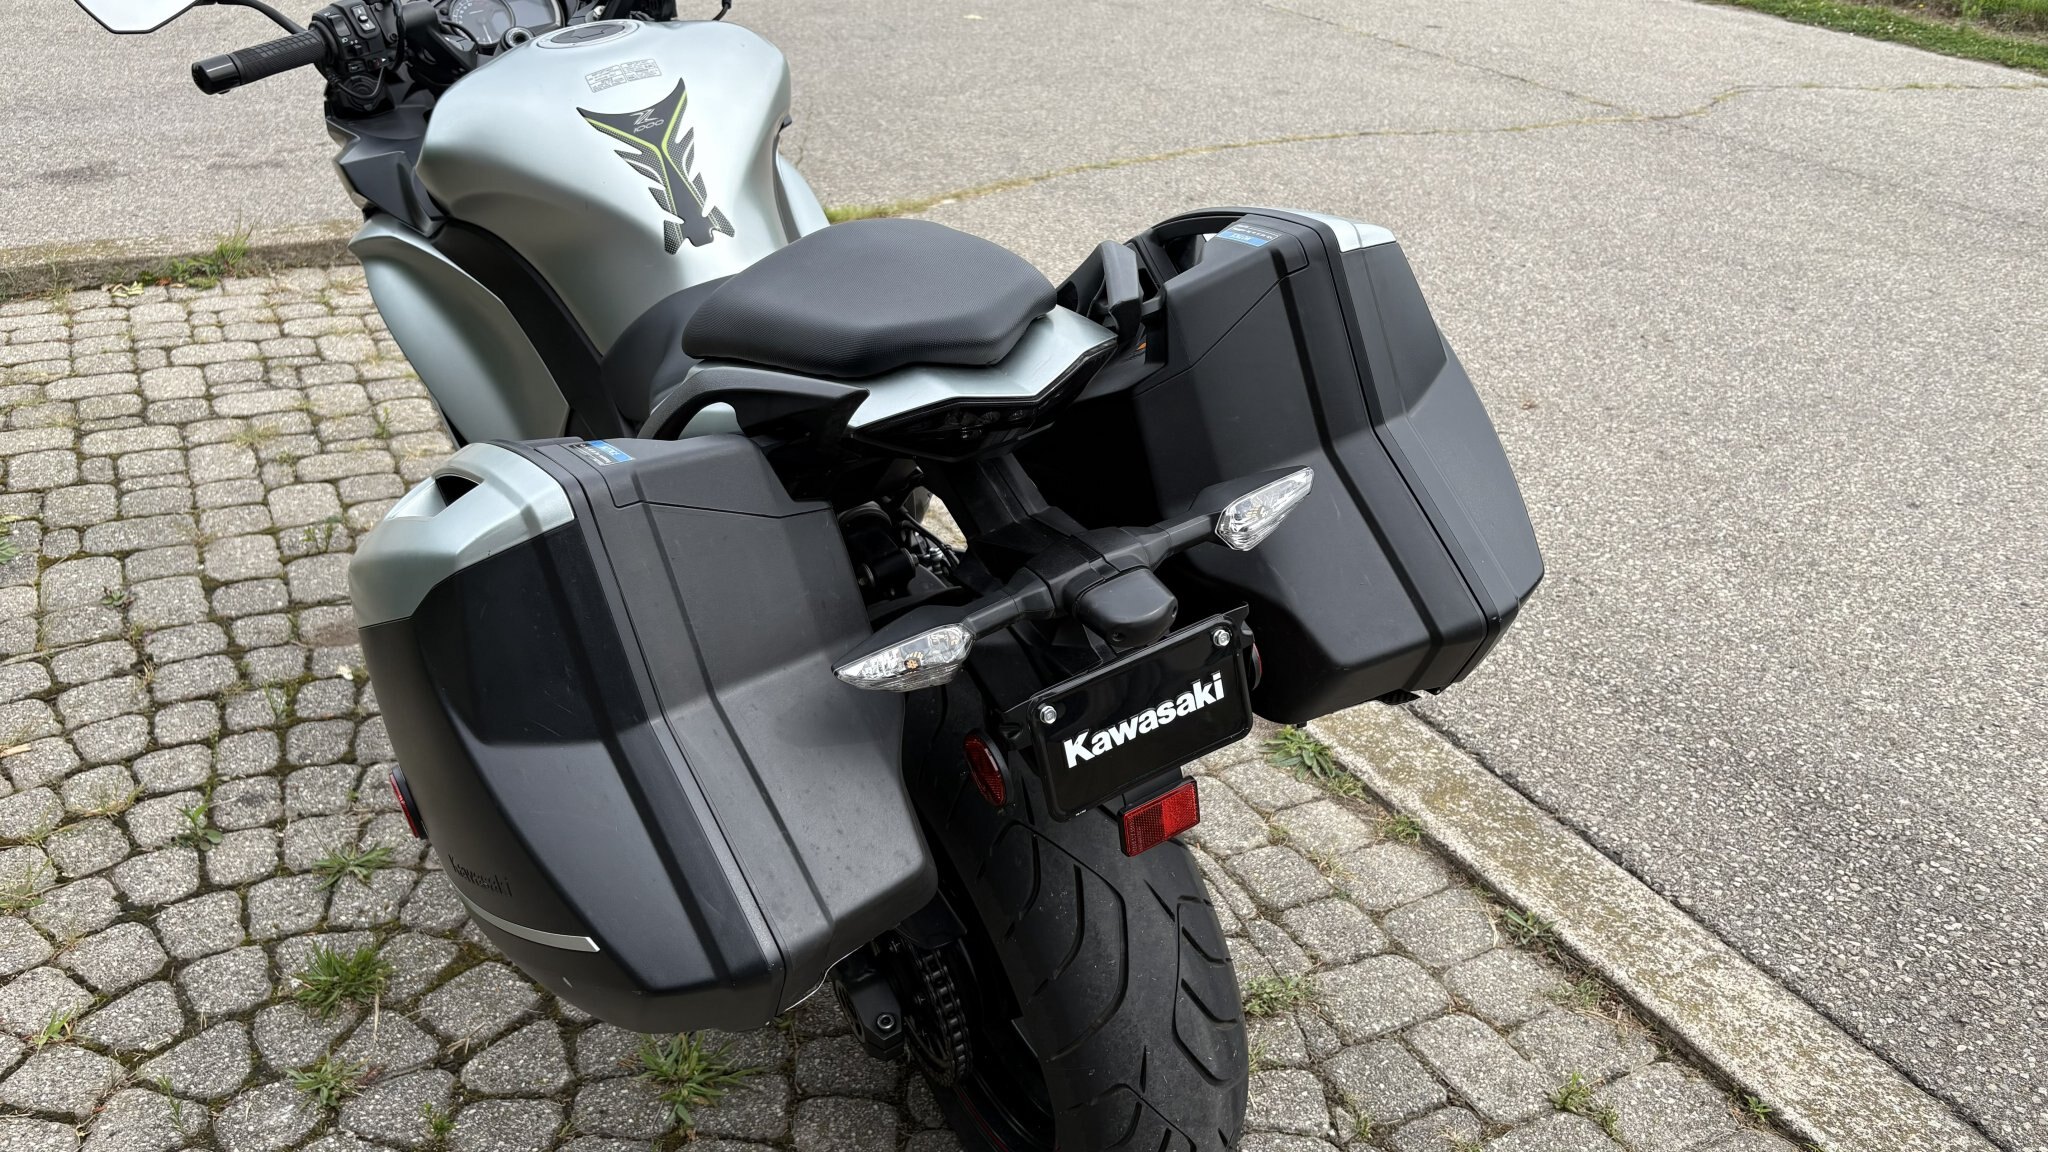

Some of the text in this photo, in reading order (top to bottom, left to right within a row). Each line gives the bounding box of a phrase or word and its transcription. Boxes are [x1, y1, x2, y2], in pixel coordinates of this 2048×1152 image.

[629, 108, 659, 125] Z
[633, 119, 665, 133] 1000
[1063, 670, 1225, 769] Kawasaki
